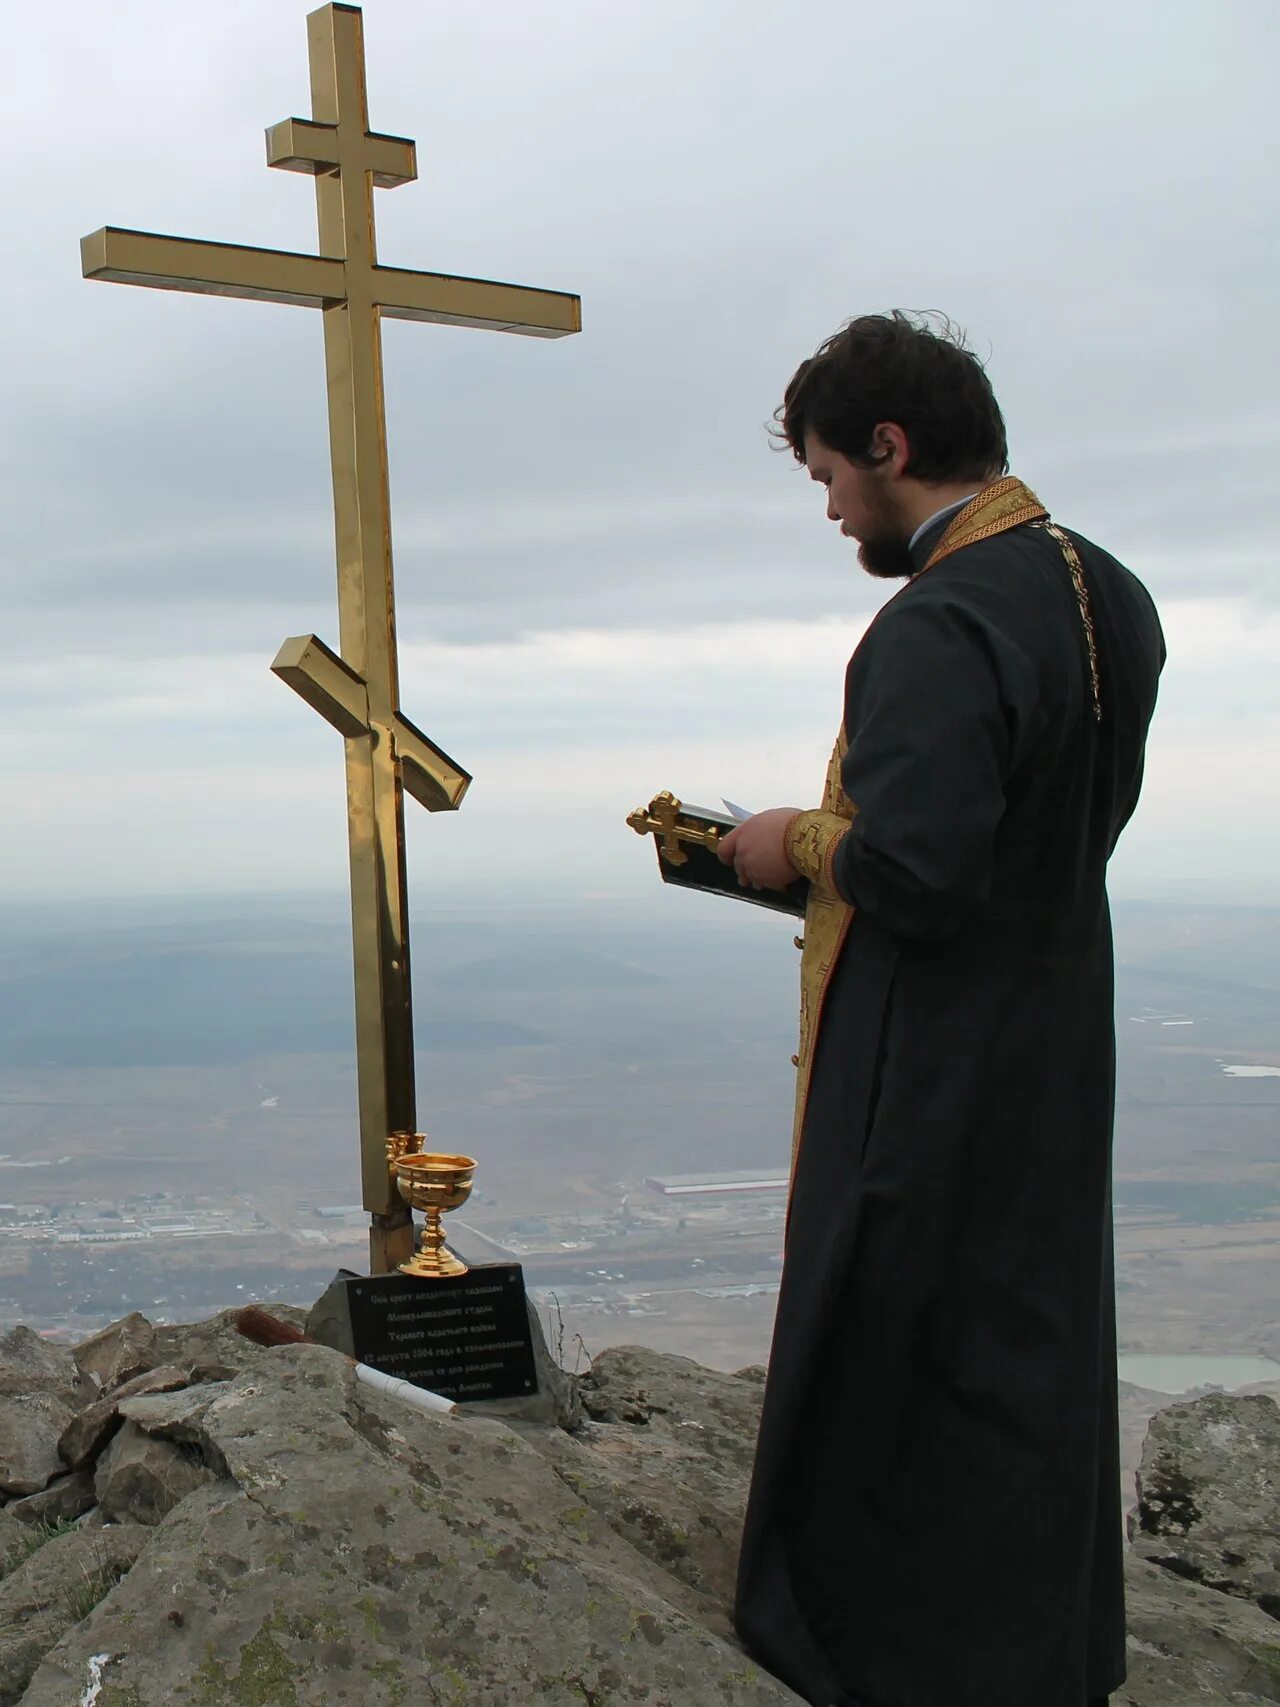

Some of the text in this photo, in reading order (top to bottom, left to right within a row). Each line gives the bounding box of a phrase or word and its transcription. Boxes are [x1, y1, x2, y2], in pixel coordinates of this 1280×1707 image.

[390, 1293, 413, 1304] крест
[388, 1329, 424, 1343] Терского
[413, 1348, 433, 1359] 2004
[436, 1347, 454, 1357] года
